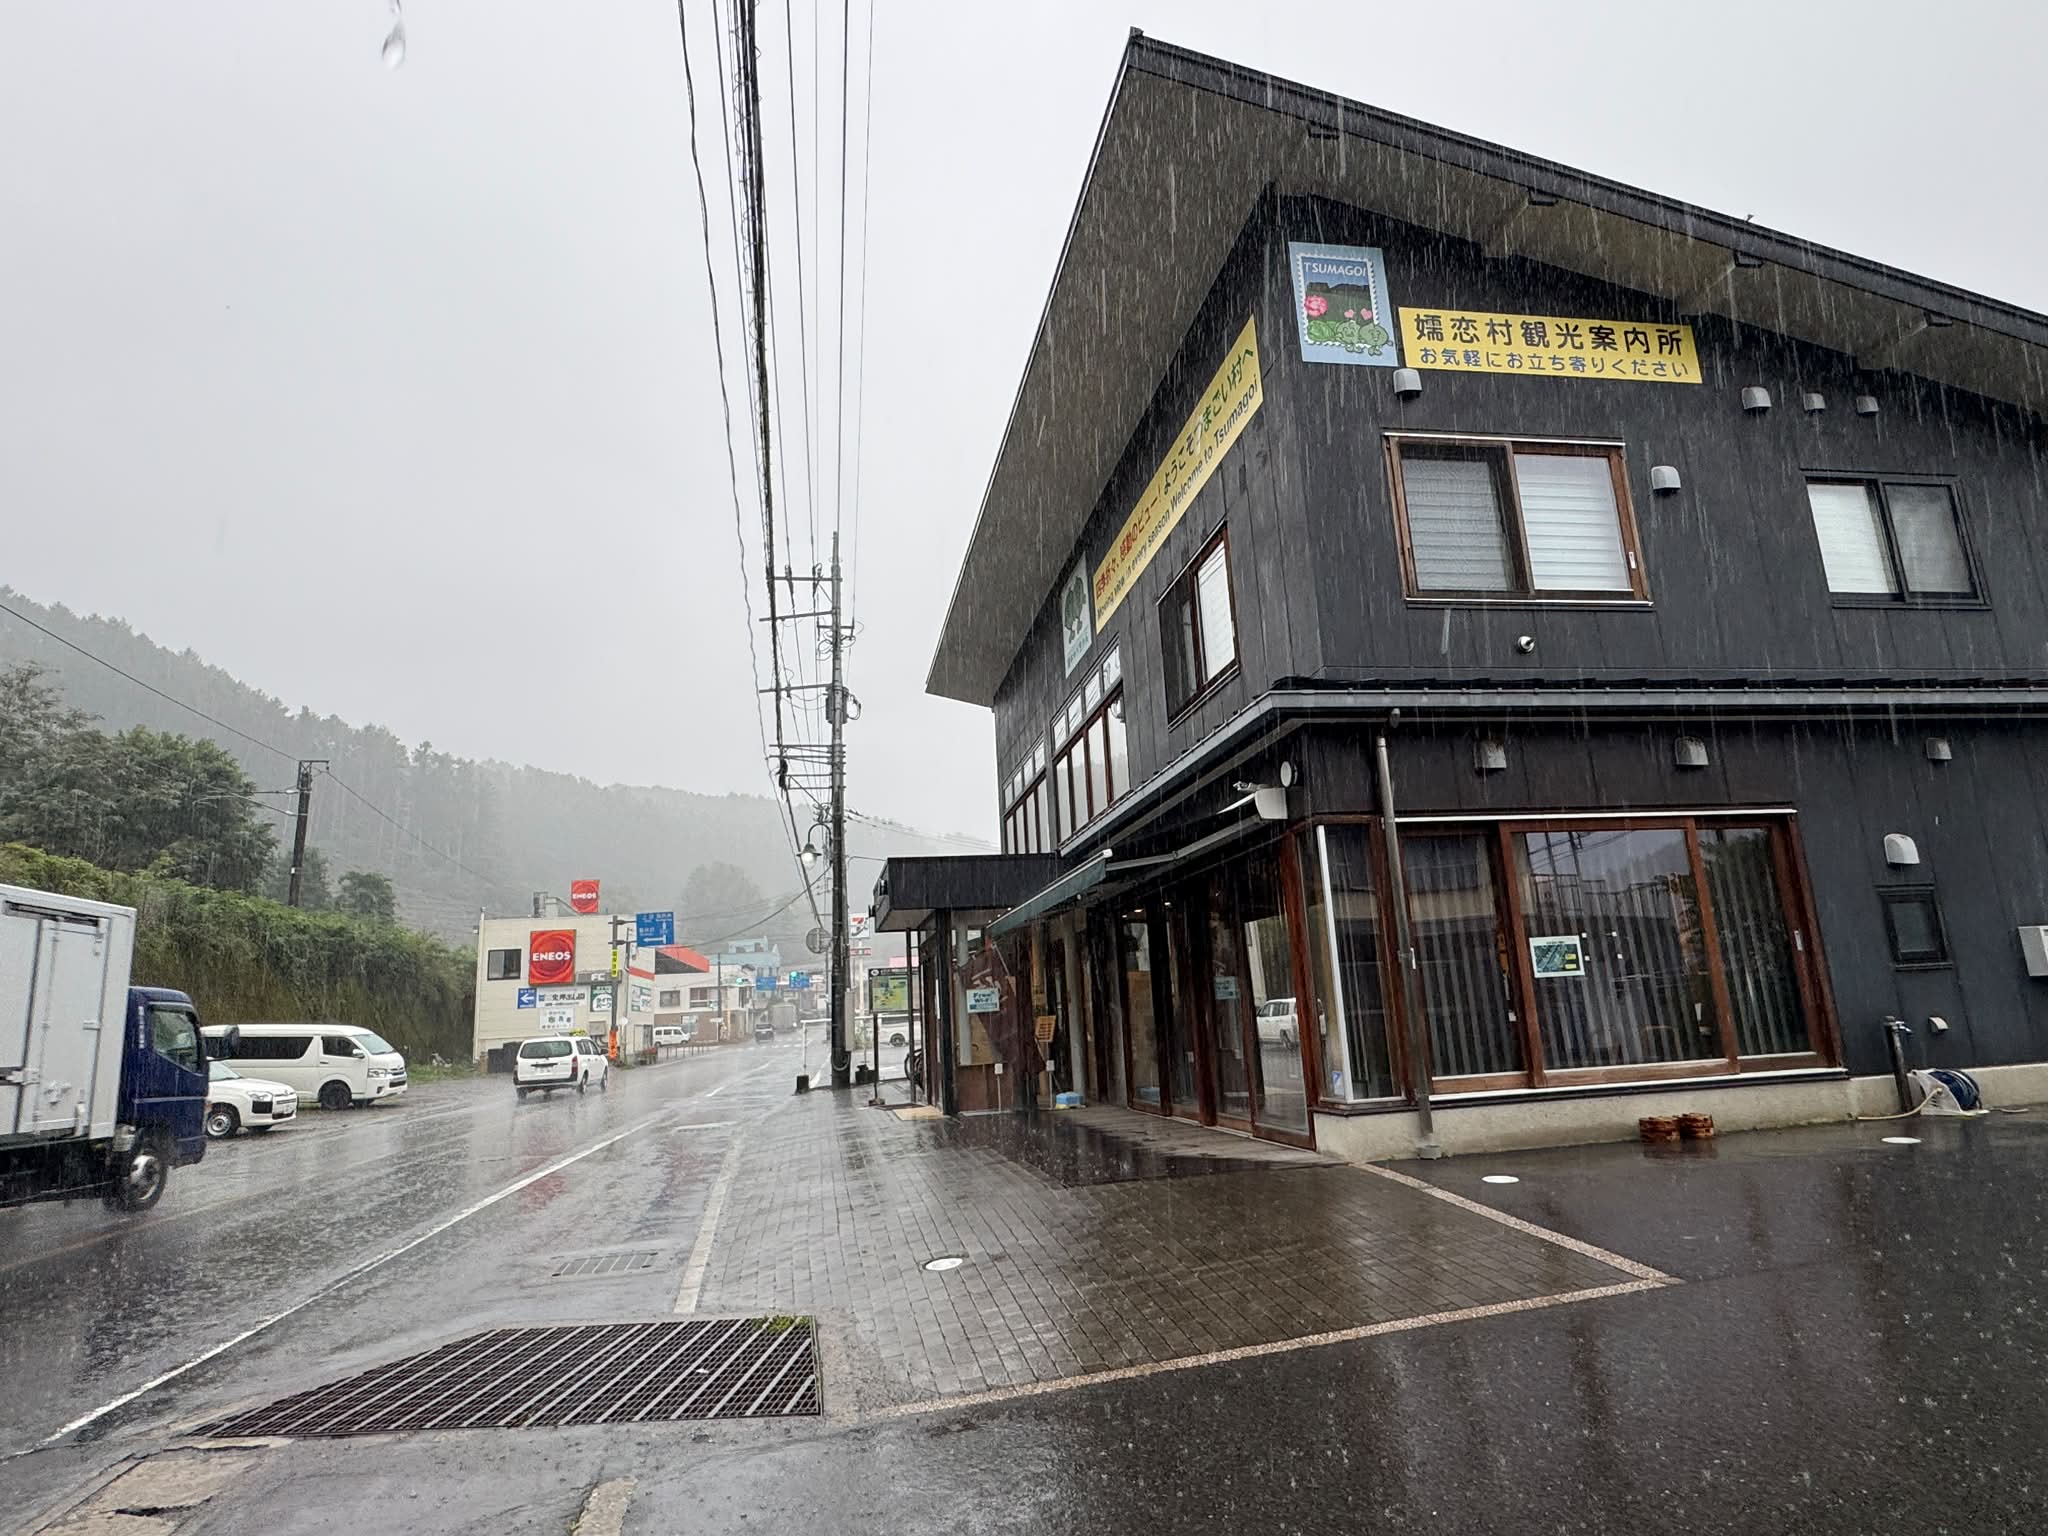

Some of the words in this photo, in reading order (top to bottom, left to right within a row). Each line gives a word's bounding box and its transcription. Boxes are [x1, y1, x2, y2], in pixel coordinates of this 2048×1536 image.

[1303, 260, 1368, 279] TSUMAGOI
[1414, 312, 1684, 357] 嬬恋村観光案内所
[1418, 347, 1690, 379] お気軽にお立ち寄りください
[1132, 546, 1148, 570] every
[1148, 510, 1170, 548] season
[1170, 461, 1204, 513] Welcome
[1203, 446, 1214, 468] to
[1213, 373, 1260, 450] Tsumagoi
[572, 892, 597, 900] ENEOS
[532, 951, 571, 961] ENEOS
